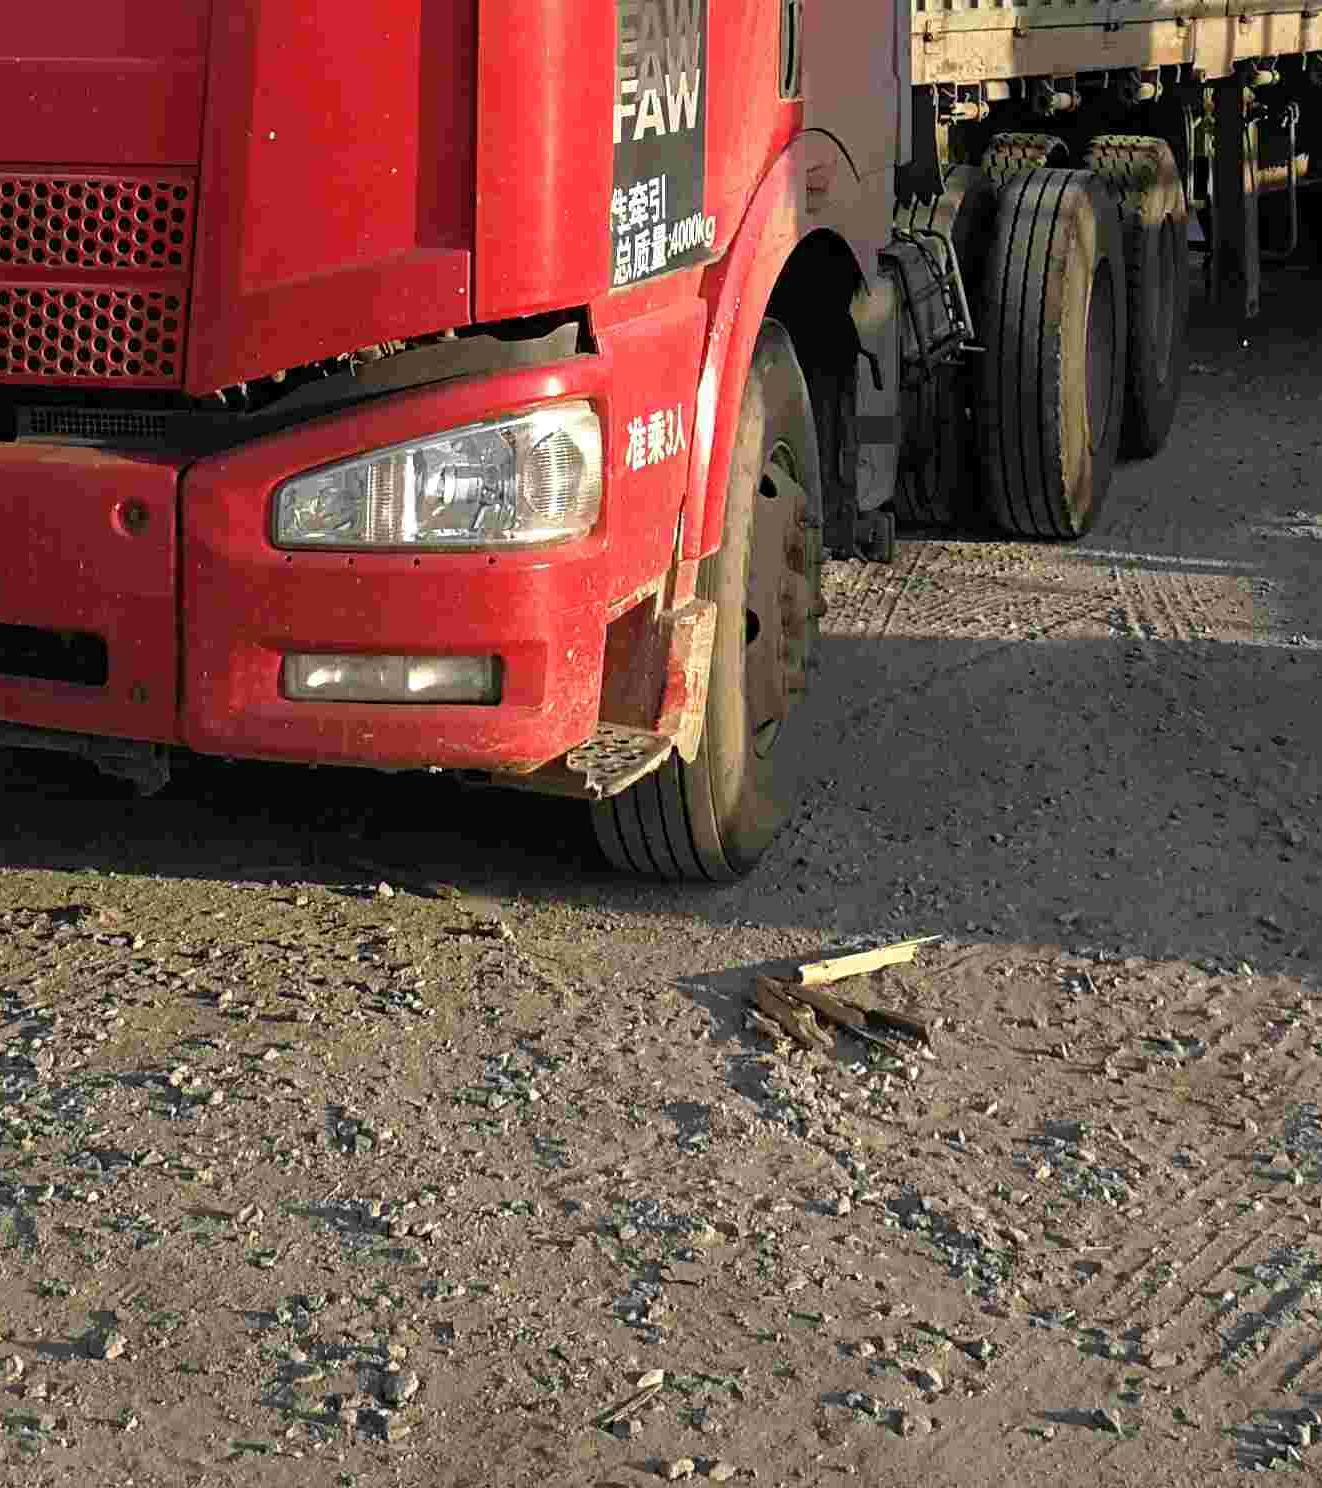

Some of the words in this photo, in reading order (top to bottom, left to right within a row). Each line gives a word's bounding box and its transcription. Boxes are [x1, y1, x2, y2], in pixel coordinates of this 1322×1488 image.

[613, 69, 700, 144] FAW
[626, 402, 686, 472] 准乘3人
